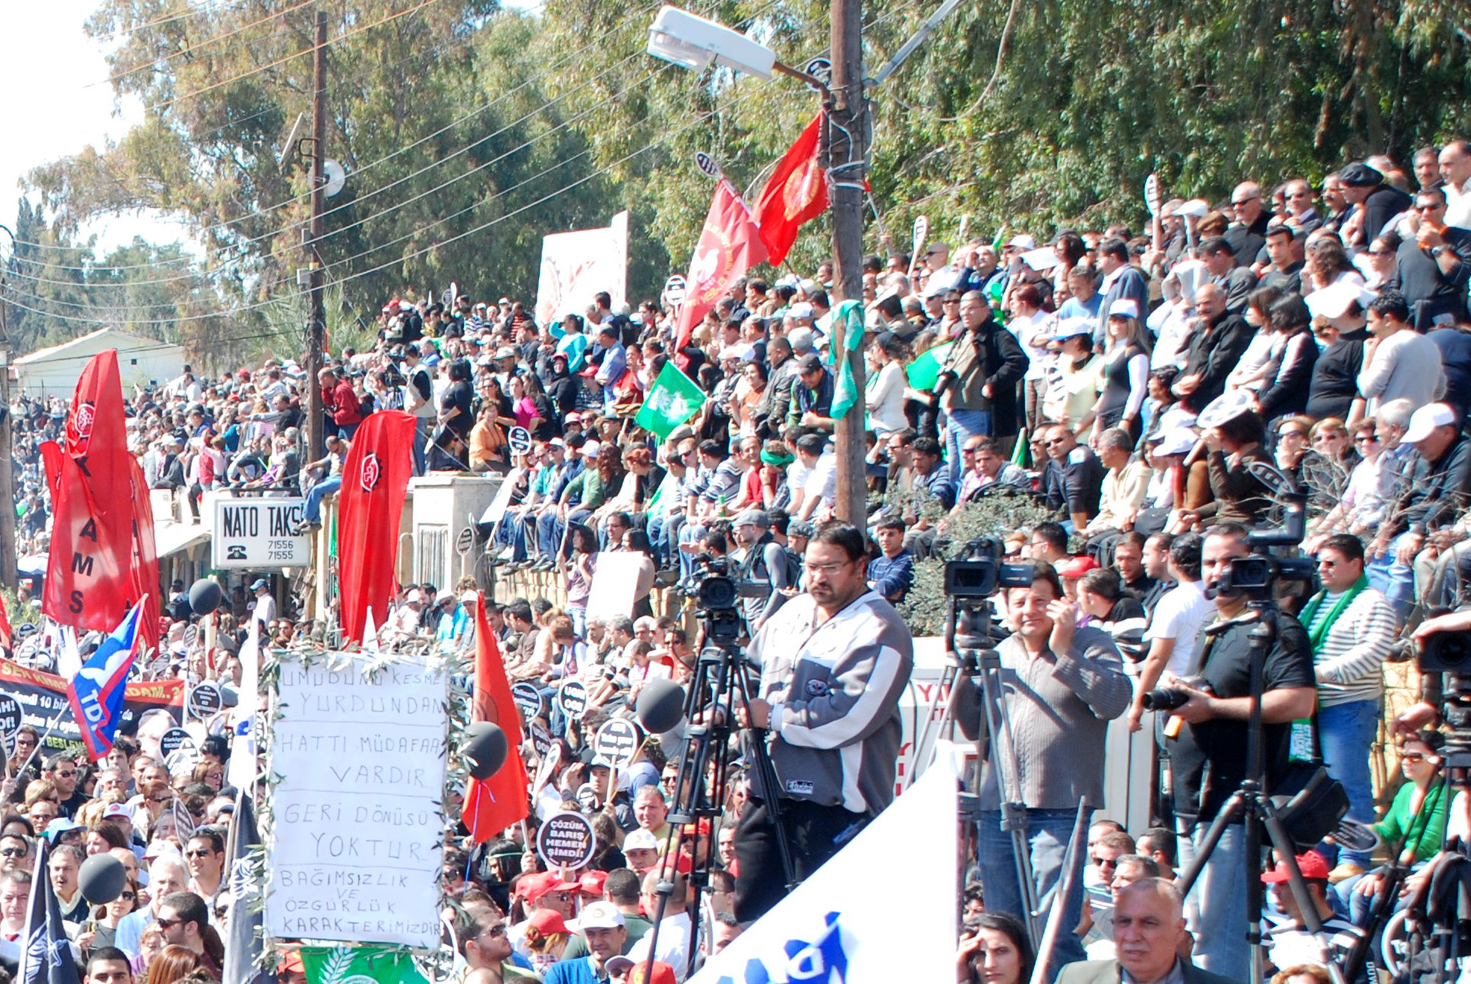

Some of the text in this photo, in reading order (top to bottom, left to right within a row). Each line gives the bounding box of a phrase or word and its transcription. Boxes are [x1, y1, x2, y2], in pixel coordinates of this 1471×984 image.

[224, 507, 258, 537] NATO
[268, 540, 293, 549] 71556
[268, 551, 293, 560] 71555
[300, 692, 442, 715] YURDUNDAN
[281, 734, 440, 754] HATTI MÜDAFAA
[284, 802, 342, 823] GERİ
[550, 819, 586, 831] ÇÖZÜM,
[549, 830, 585, 841] BARIŞ
[546, 839, 587, 848] HEMEN
[548, 847, 584, 860] ŞİMDİ!
[280, 868, 408, 887] BAĞIMSIZLIK
[336, 888, 360, 899] VE
